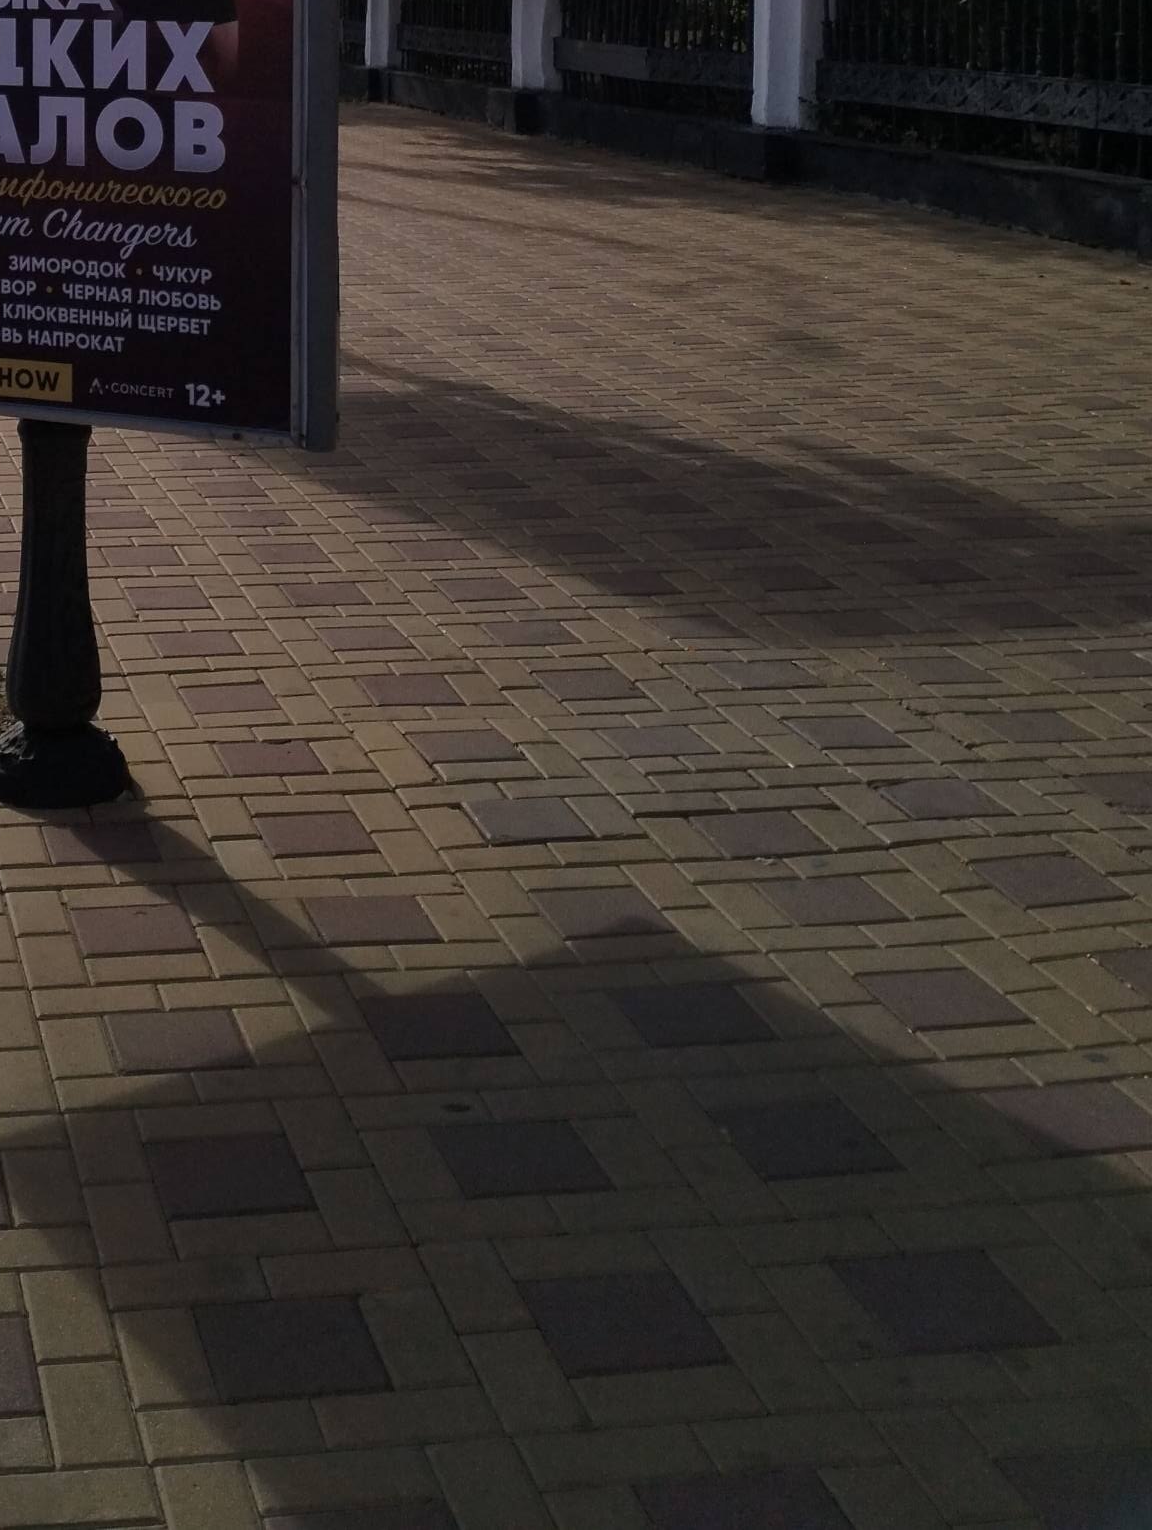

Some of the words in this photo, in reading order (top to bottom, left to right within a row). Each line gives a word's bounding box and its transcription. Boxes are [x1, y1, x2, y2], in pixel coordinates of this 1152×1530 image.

[43, 208, 197, 259] Changers
[9, 255, 126, 279] ЗИМОРОДОК
[153, 265, 212, 285] ЧУКУР
[62, 283, 133, 304] ЧЕРНАЯ
[137, 289, 222, 311] ЛЮБОВЬ
[3, 303, 133, 329] КЛЮКВЕННЫЙ
[138, 313, 211, 336] ЩЕРБЕТ
[28, 329, 126, 353] НАПРОКАТ
[185, 383, 226, 407] 12+
